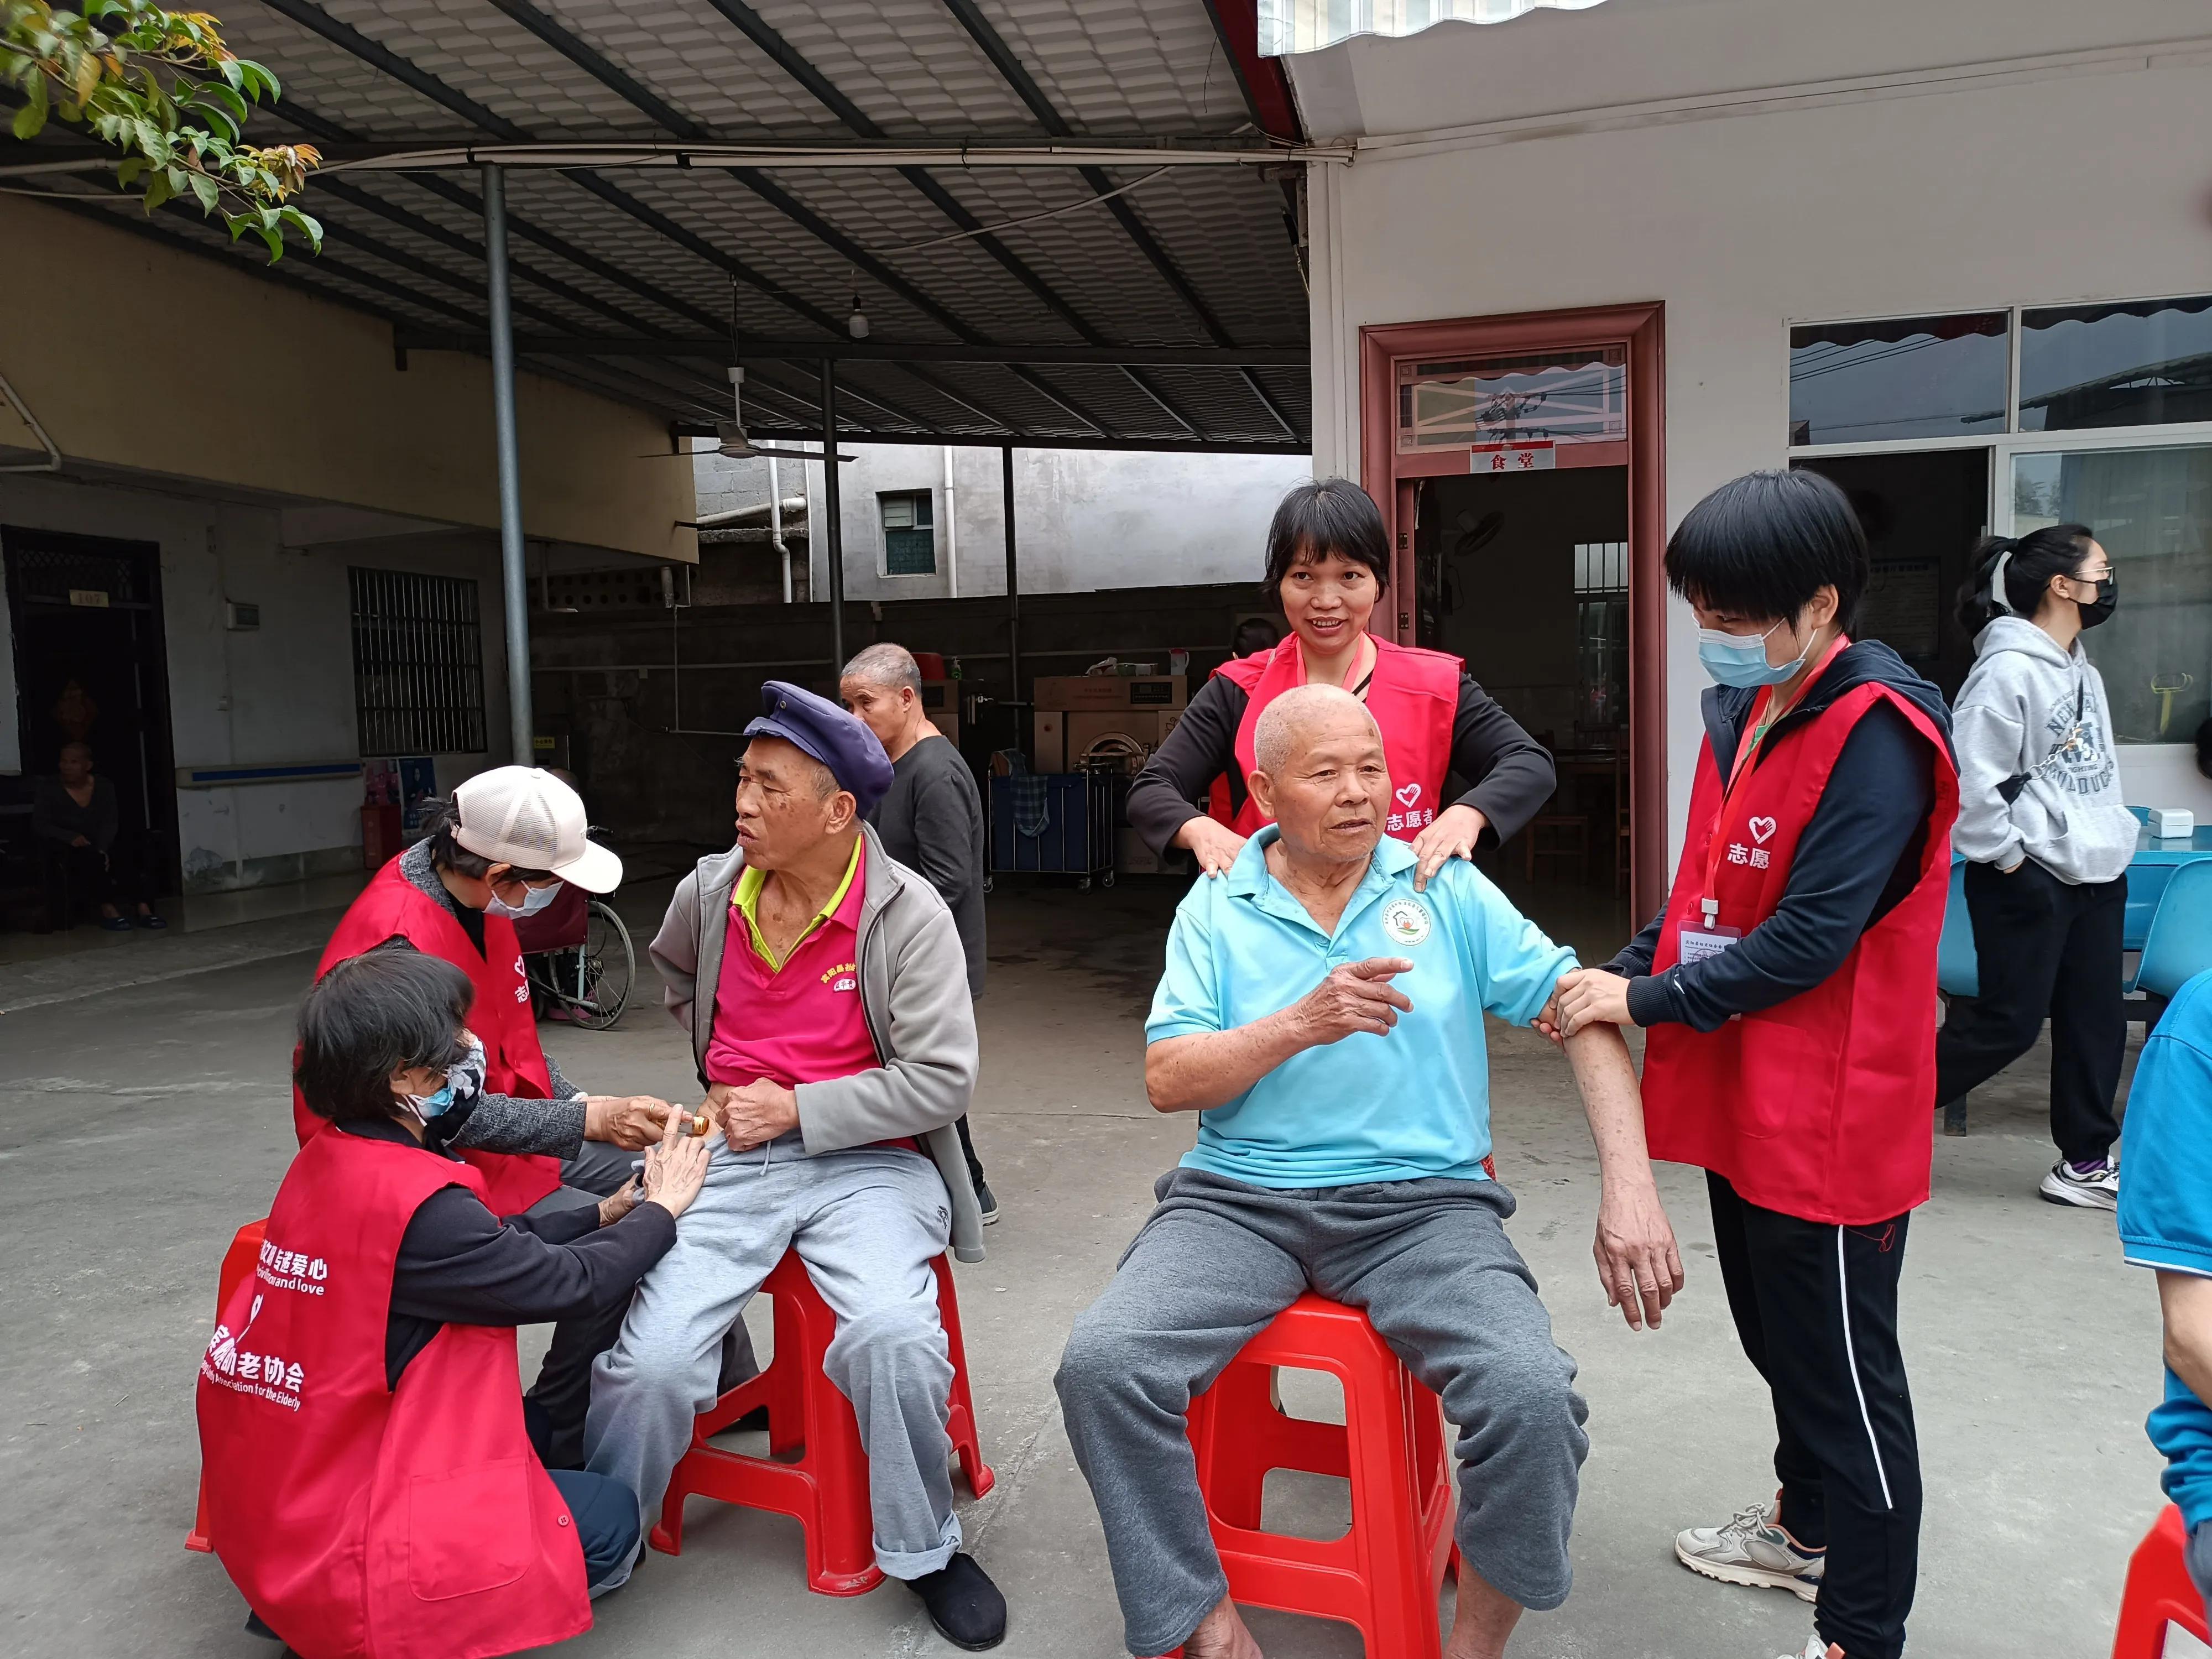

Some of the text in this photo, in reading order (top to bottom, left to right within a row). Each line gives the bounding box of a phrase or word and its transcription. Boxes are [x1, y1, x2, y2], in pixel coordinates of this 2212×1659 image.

[1490, 452, 1535, 470] 食堂
[78, 593, 100, 604] 107
[1387, 808, 1433, 832] 志愿者
[1727, 843, 1771, 869] 志愿
[515, 979, 530, 1003] 志
[275, 1277, 296, 1290] and
[297, 1279, 324, 1296] love
[215, 1373, 253, 1394] Association
[255, 1383, 266, 1396] for
[265, 1387, 277, 1401] the
[276, 1391, 301, 1412] Elderly
